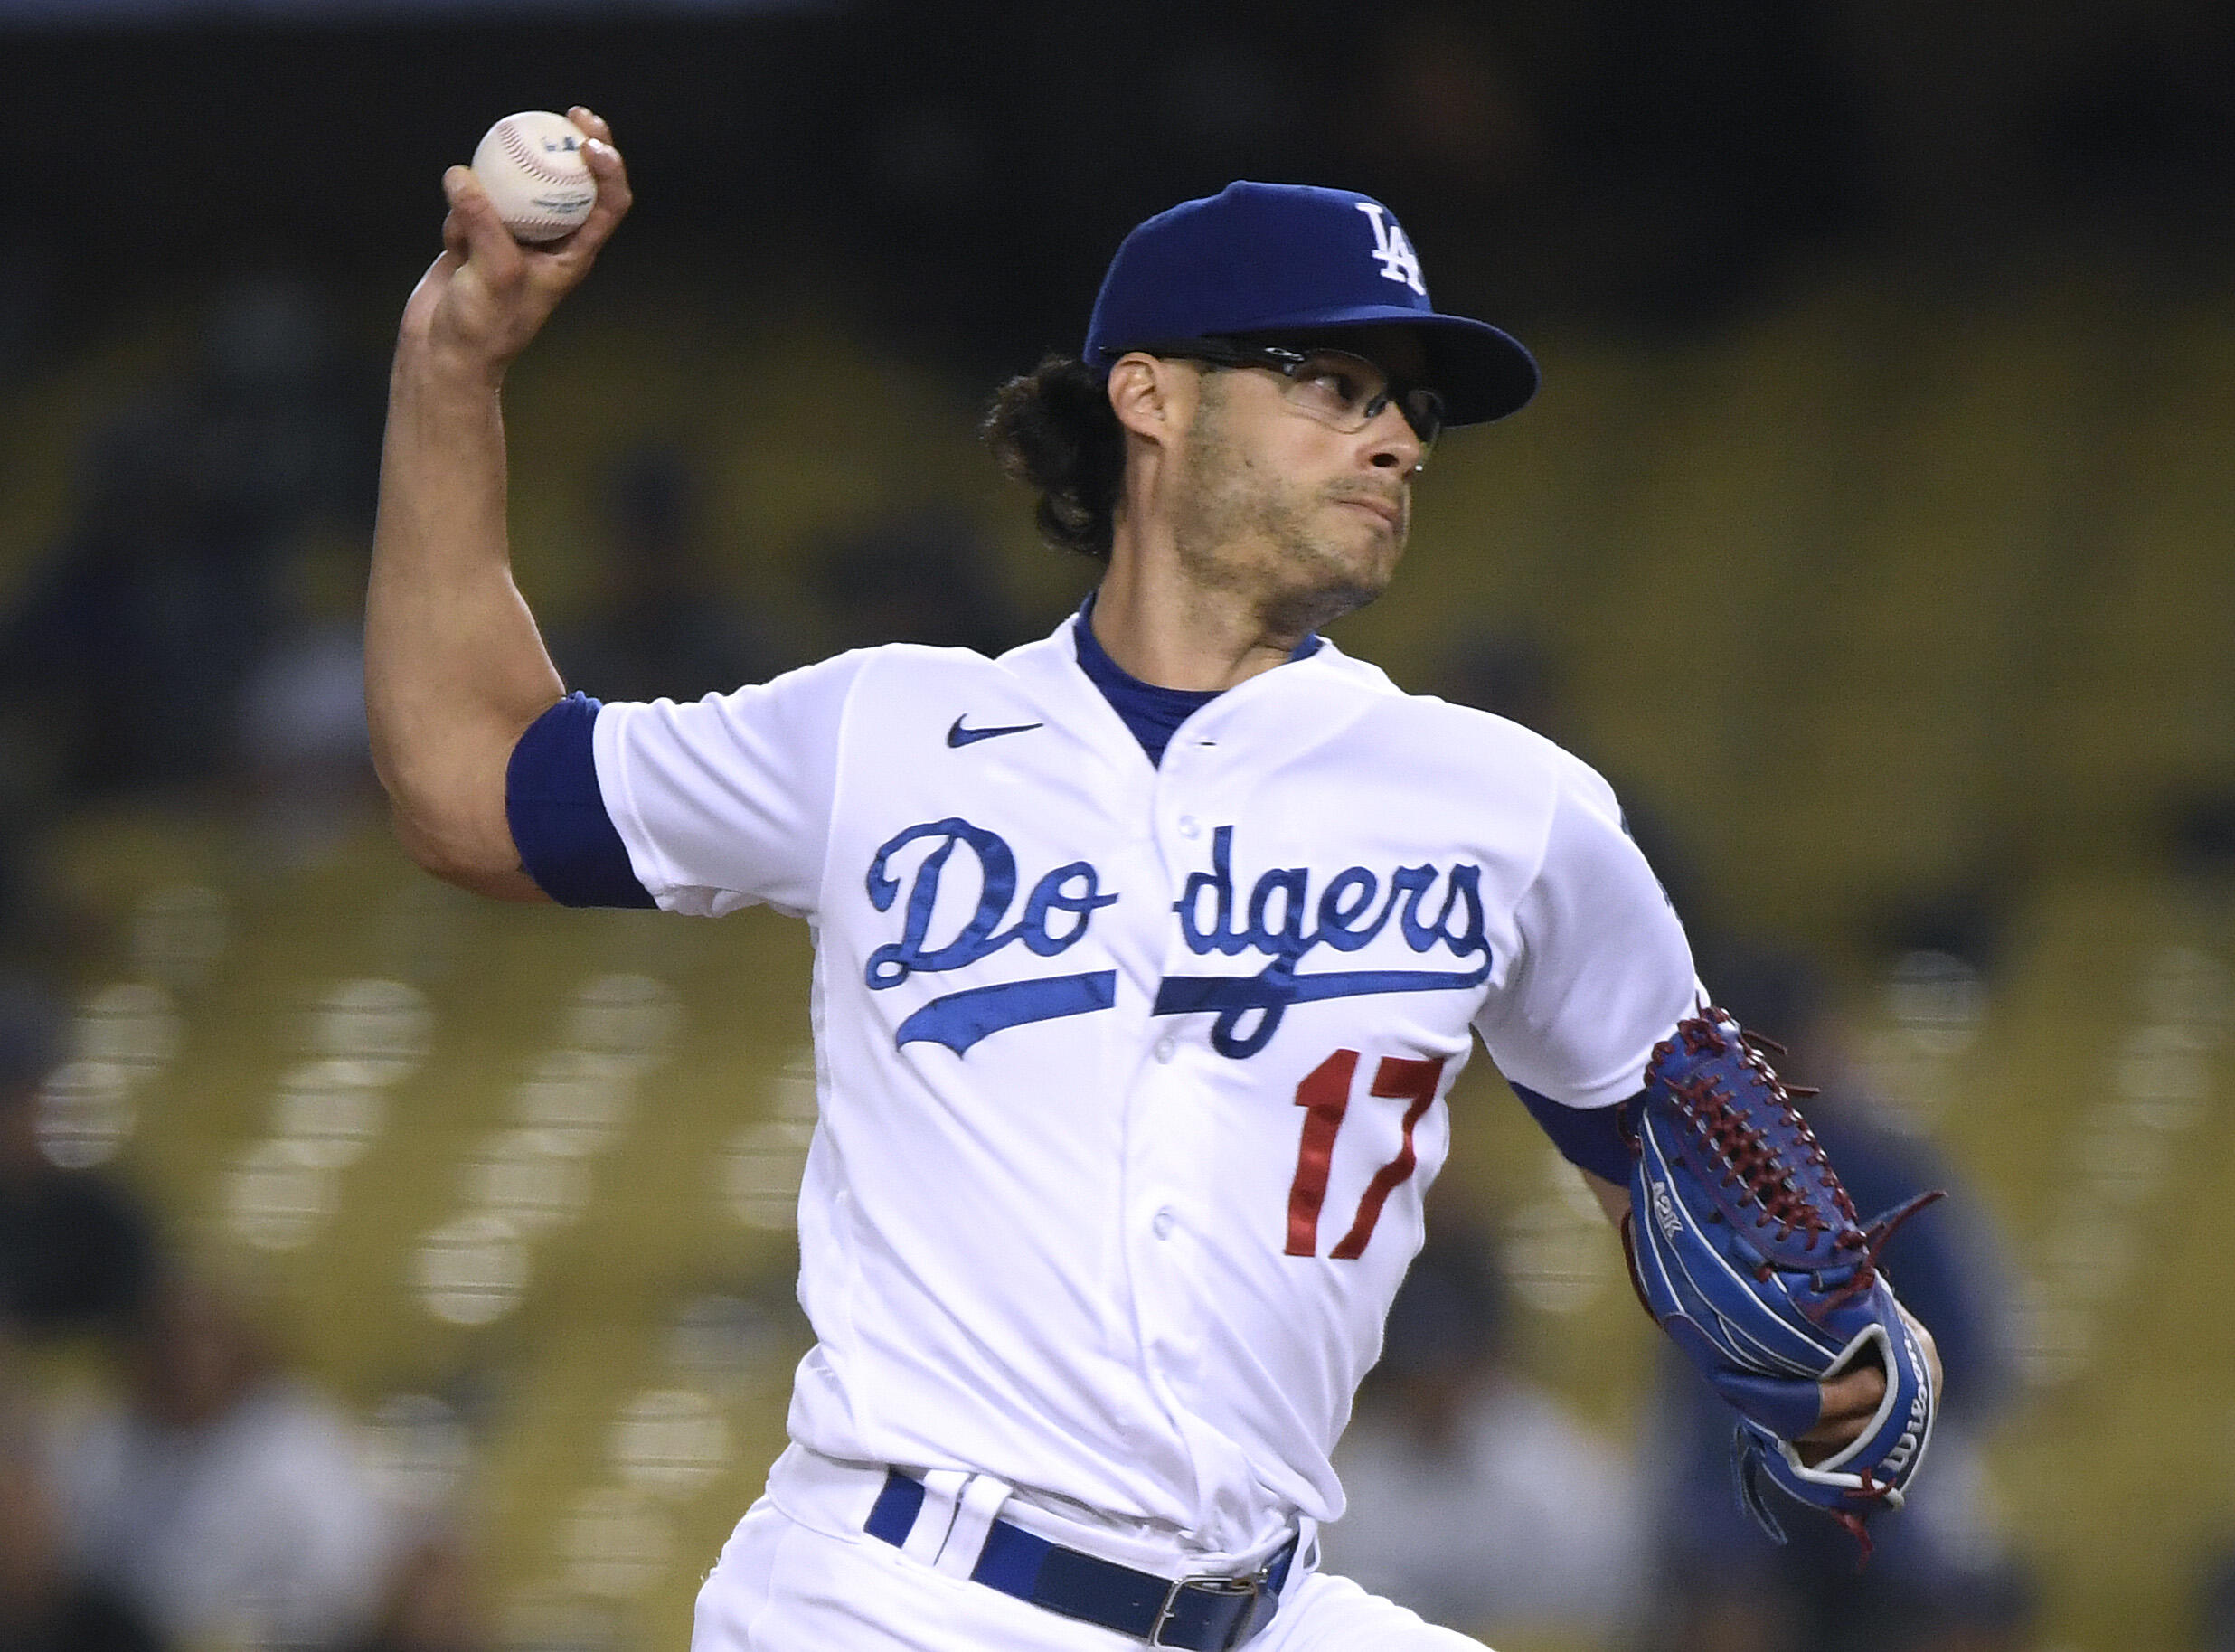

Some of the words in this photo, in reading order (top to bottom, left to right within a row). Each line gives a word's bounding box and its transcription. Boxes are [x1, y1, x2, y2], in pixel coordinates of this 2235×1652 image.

[1355, 203, 1426, 295] LA
[865, 817, 1493, 1059] Dodgers
[1283, 1048, 1446, 1260] 17
